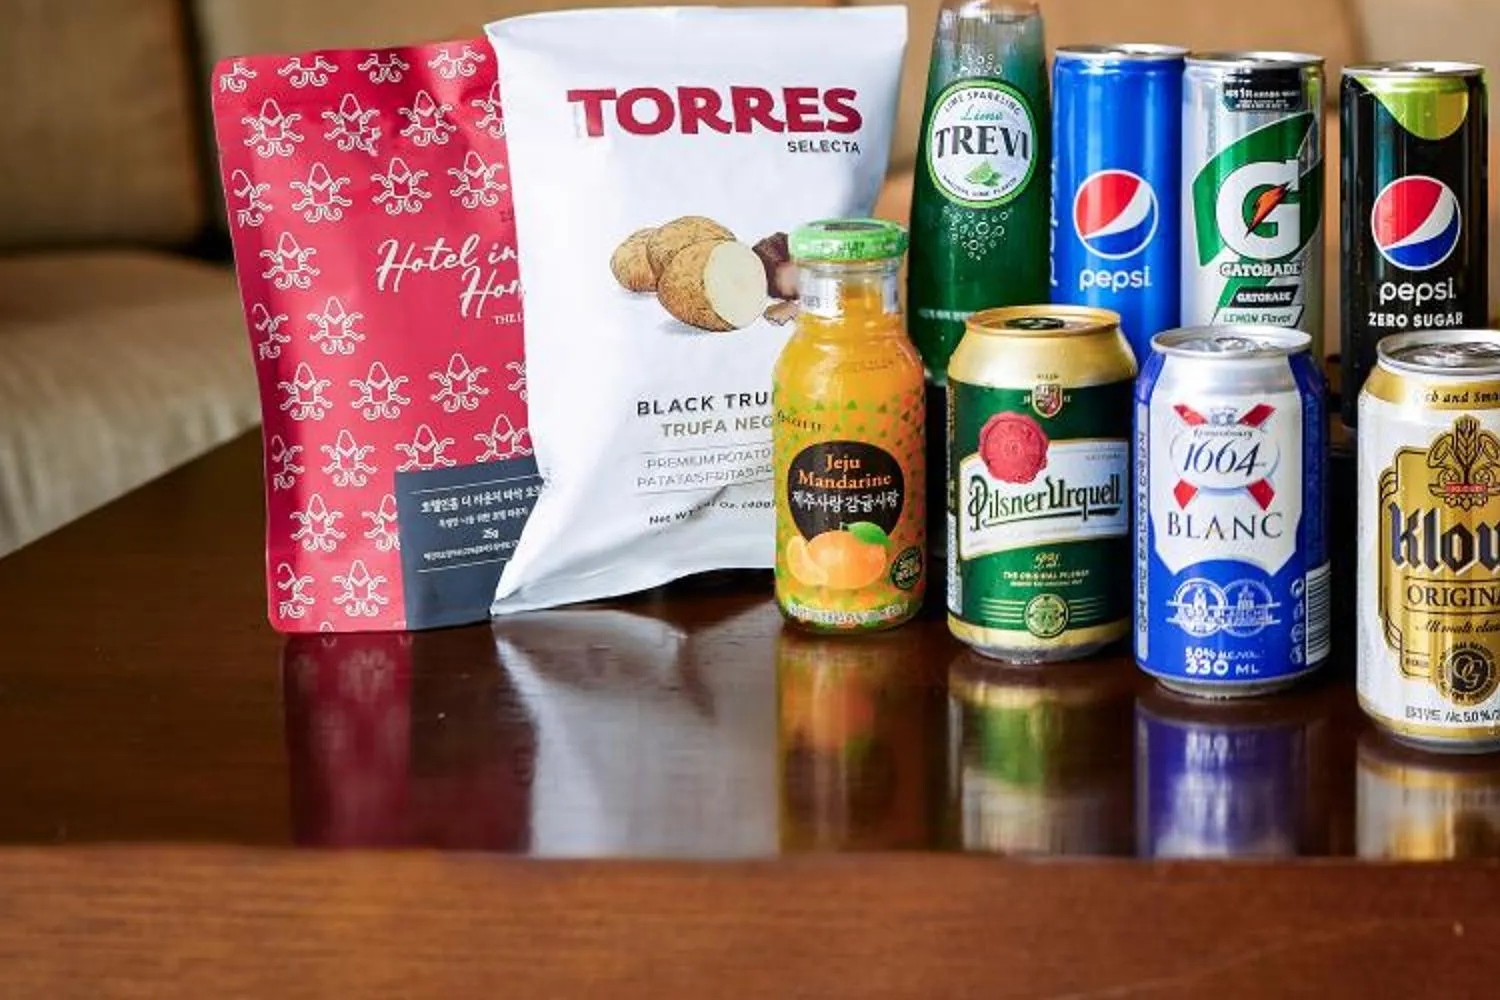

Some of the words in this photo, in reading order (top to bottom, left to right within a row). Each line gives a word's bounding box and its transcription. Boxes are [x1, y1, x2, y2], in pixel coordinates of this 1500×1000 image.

[567, 86, 862, 137] TORRES
[786, 139, 861, 154] SELECTA
[935, 125, 1029, 161] TREVI
[376, 233, 481, 294] Hotel
[487, 243, 518, 264] in
[1220, 262, 1306, 277] GATORADE
[1079, 265, 1152, 293] pepsi
[1236, 292, 1292, 303] GATORADE
[1380, 277, 1454, 306] pepsi
[495, 312, 514, 325] THE
[1223, 312, 1259, 323] LEMON
[1368, 311, 1409, 328] ZERO
[1413, 311, 1463, 327] SUGAR
[637, 396, 715, 416] BLACK
[1443, 391, 1469, 403] and
[661, 419, 727, 437] TRUFA
[735, 415, 773, 431] NEG
[645, 453, 715, 469] PREMIUM
[825, 453, 862, 476] Jeju
[1183, 438, 1261, 477] 1664
[637, 472, 703, 488] PATATAS
[705, 467, 754, 482] FRITAS
[798, 469, 892, 490] Mandarine
[967, 474, 1047, 532] Pilsner
[1045, 473, 1123, 522] Urquell
[649, 514, 671, 526] Net
[1168, 510, 1284, 542] BLANC
[1185, 659, 1230, 675] 330
[1235, 663, 1261, 674] ML
